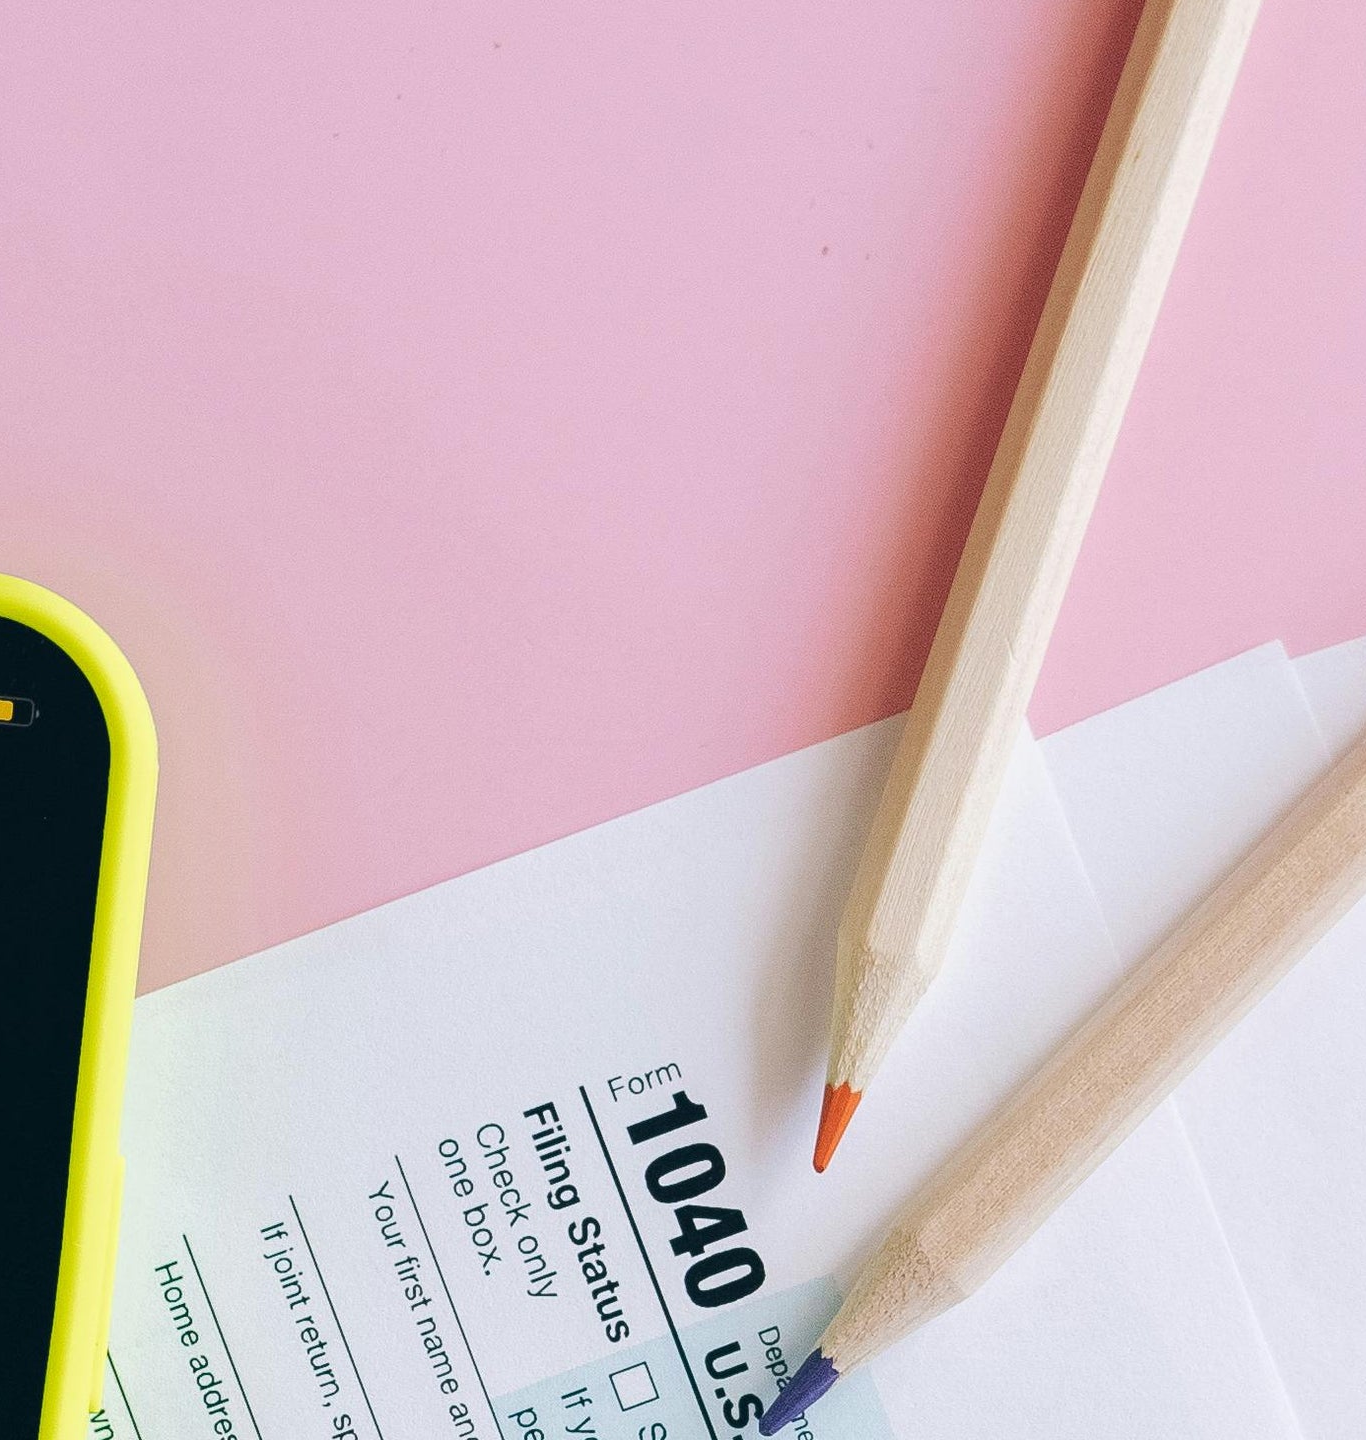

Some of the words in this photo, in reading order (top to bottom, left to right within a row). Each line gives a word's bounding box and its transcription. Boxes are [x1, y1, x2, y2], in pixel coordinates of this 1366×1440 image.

[607, 1062, 682, 1102] Form
[259, 1221, 289, 1242] If
[438, 1138, 475, 1198] one
[462, 1202, 502, 1277] box.
[475, 1122, 532, 1228] Check
[517, 1234, 558, 1298] only
[522, 1100, 581, 1211] Filing
[567, 1215, 631, 1344] Status
[625, 1090, 767, 1309] 1040
[154, 1260, 200, 1348] Home
[262, 1246, 311, 1311] joint
[367, 1179, 407, 1248] Your
[393, 1255, 433, 1313] first
[415, 1316, 460, 1395] name
[295, 1314, 340, 1408] return,
[560, 1386, 593, 1410] If
